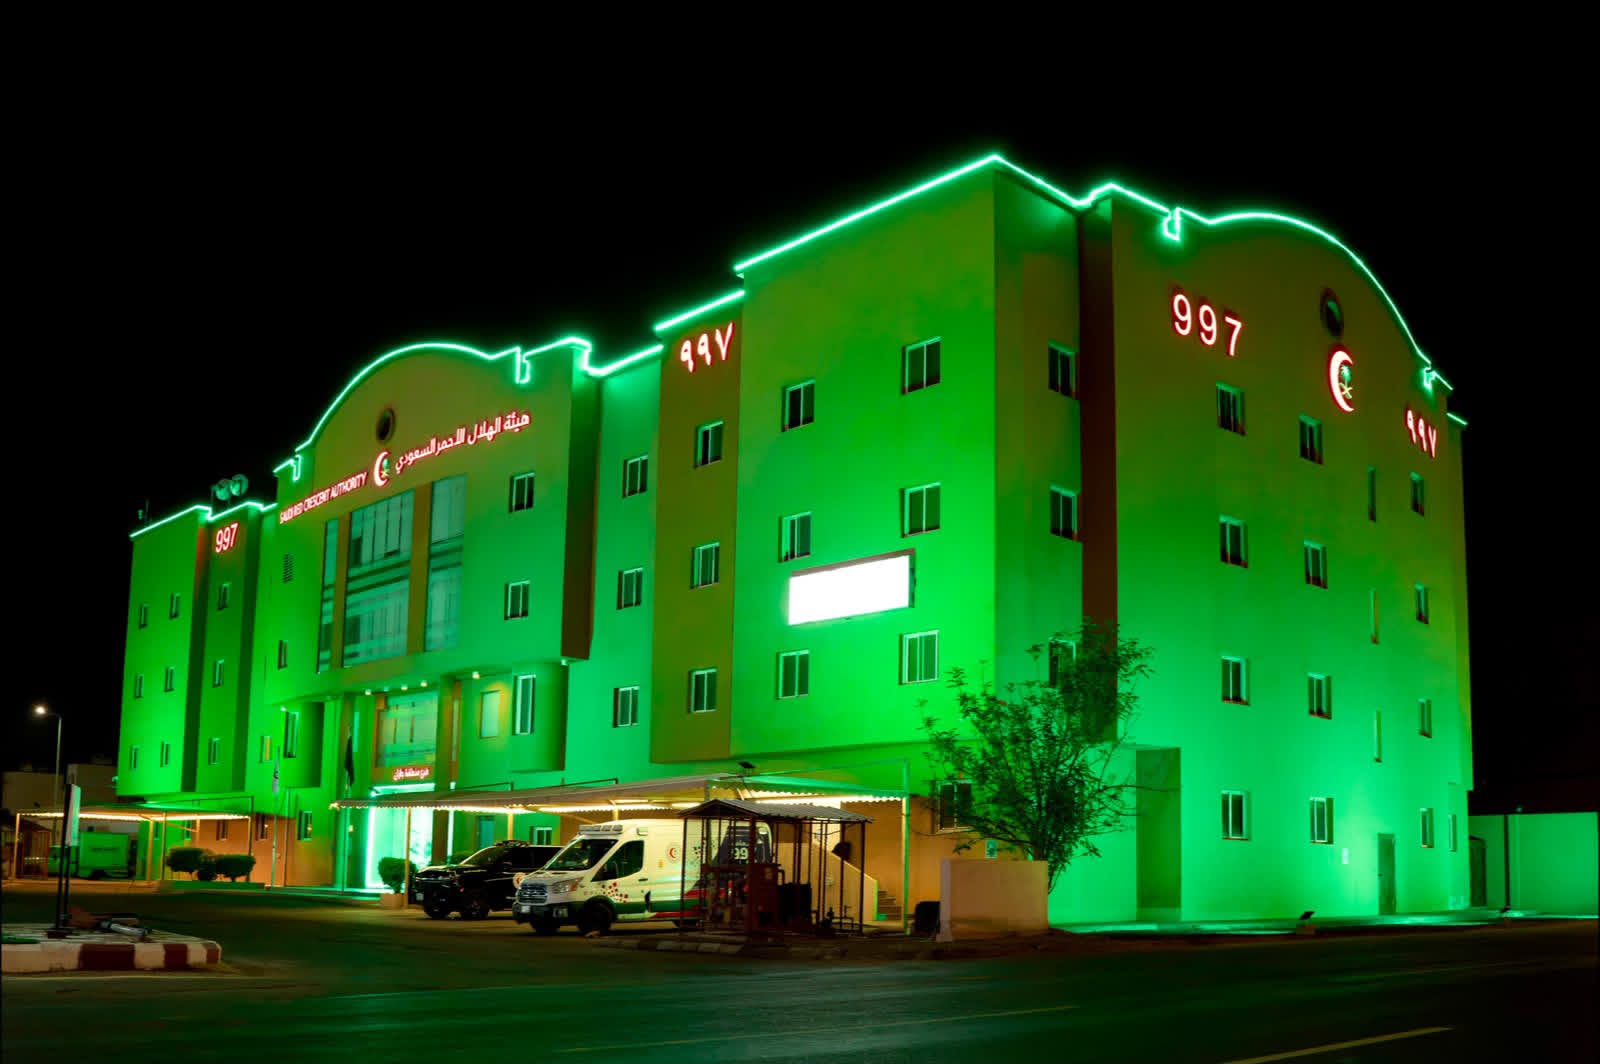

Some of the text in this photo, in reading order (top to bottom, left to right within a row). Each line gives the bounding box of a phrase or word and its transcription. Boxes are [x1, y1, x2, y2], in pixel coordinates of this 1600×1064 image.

[1172, 293, 1242, 356] 997
[680, 321, 734, 373] ٩٩٧
[467, 416, 502, 445] الهلال
[503, 411, 530, 432] هيئة
[1406, 409, 1437, 458] ٩٩٧
[395, 437, 436, 474] السعودي
[330, 472, 368, 499] AUTHORITY
[215, 522, 238, 553] 997
